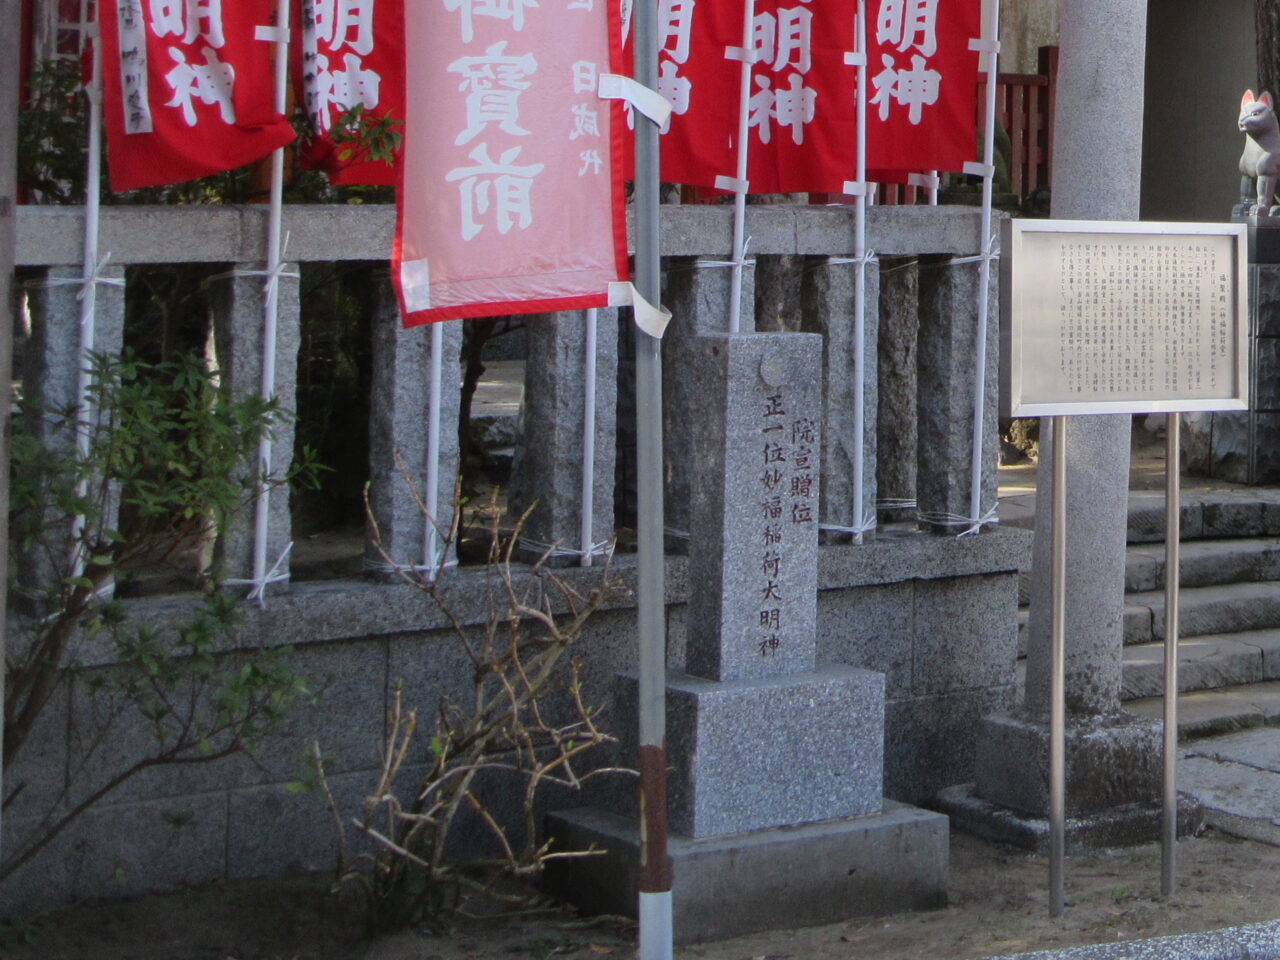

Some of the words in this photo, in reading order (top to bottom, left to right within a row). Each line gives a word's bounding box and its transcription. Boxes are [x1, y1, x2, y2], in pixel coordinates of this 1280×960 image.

[758, 394, 786, 658] 正一位妙福稲荷大明神
